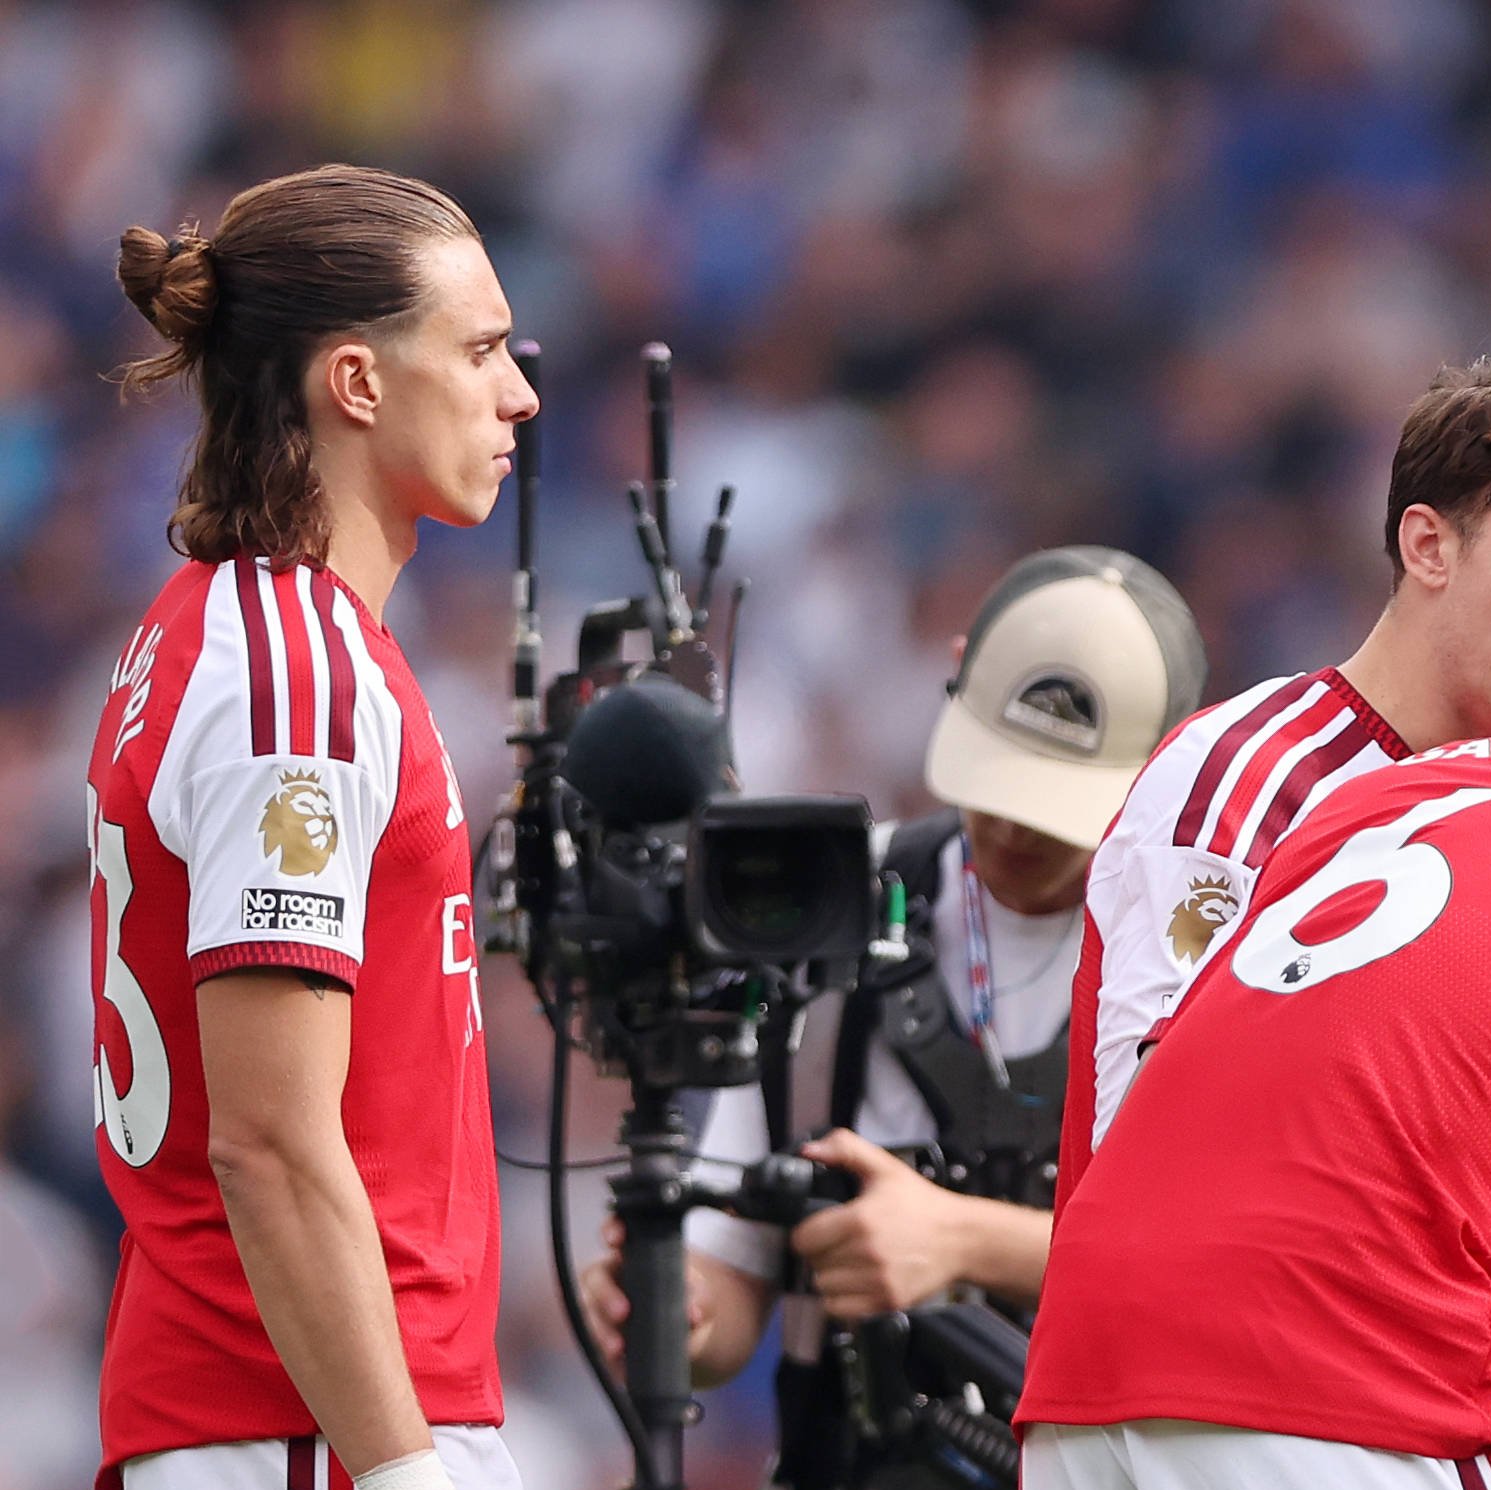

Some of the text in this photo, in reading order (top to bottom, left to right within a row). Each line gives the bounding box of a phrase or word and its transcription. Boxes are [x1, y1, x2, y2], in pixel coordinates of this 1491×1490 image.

[243, 889, 336, 918] No room
[242, 908, 343, 937] for racism
[87, 781, 171, 1168] 3
